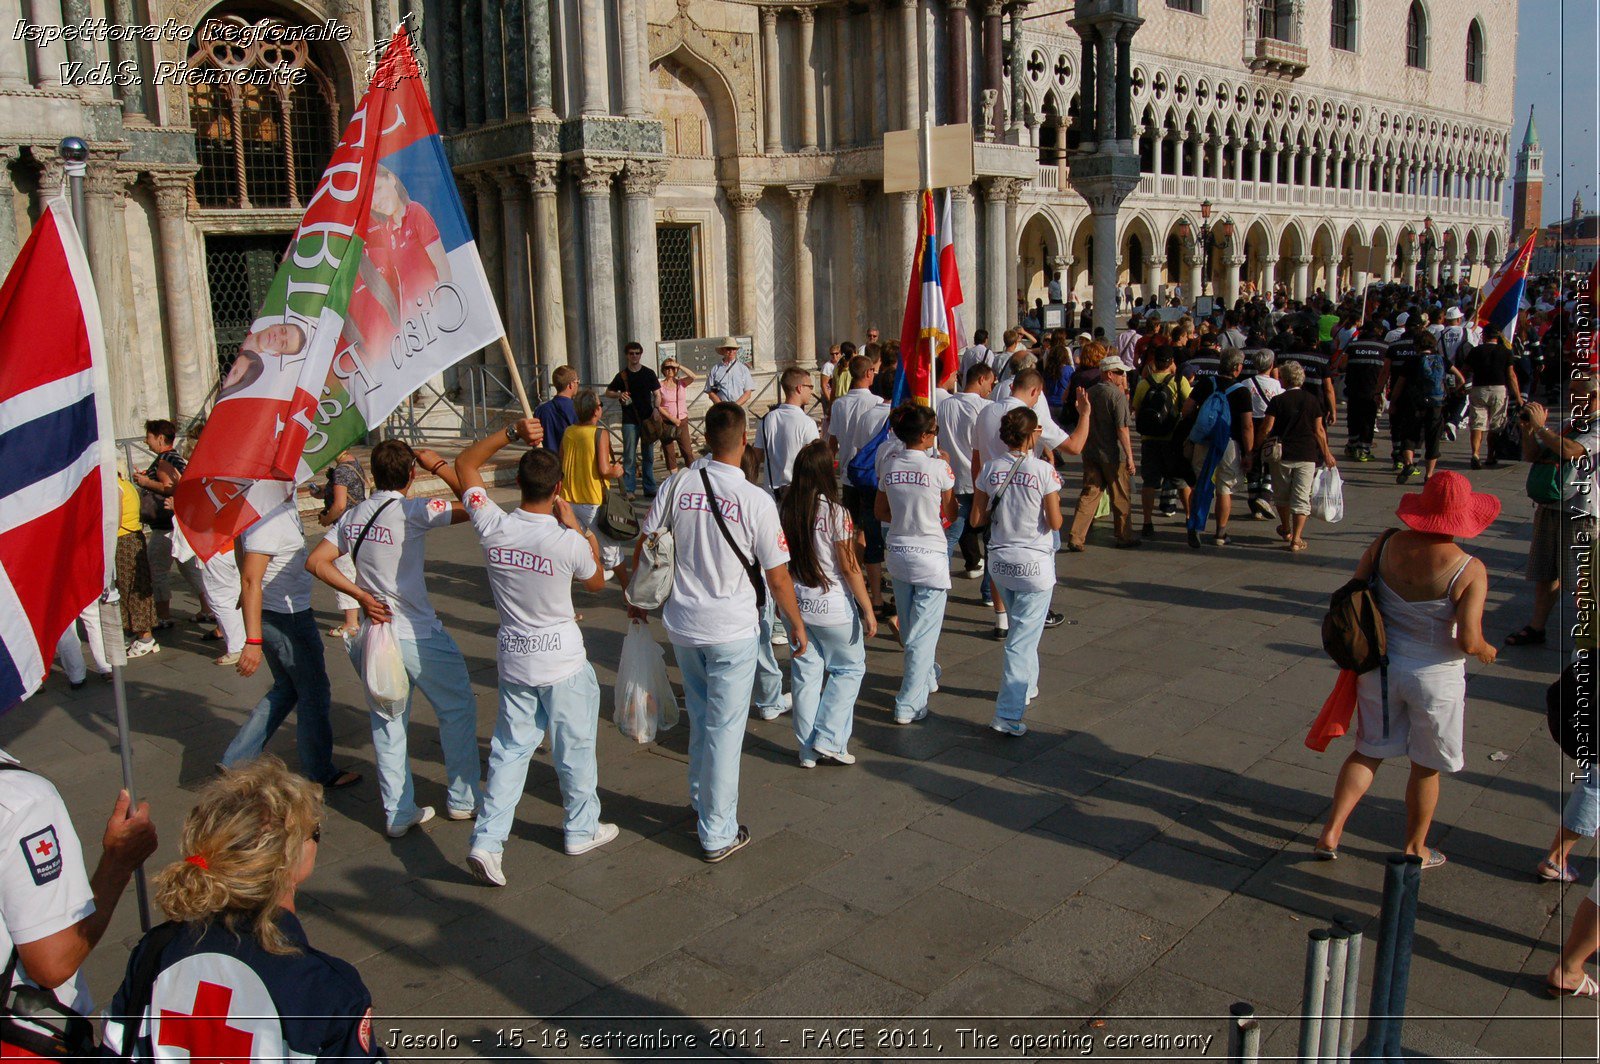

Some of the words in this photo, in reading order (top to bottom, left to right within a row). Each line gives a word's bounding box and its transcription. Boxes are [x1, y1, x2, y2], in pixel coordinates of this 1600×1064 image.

[884, 470, 931, 488] SERBIA
[989, 471, 1039, 489] SEBIA
[343, 523, 394, 546] SEBIA
[488, 546, 555, 577] SERBIA
[992, 561, 1041, 578] SERBIA
[500, 632, 562, 656] SERBIA
